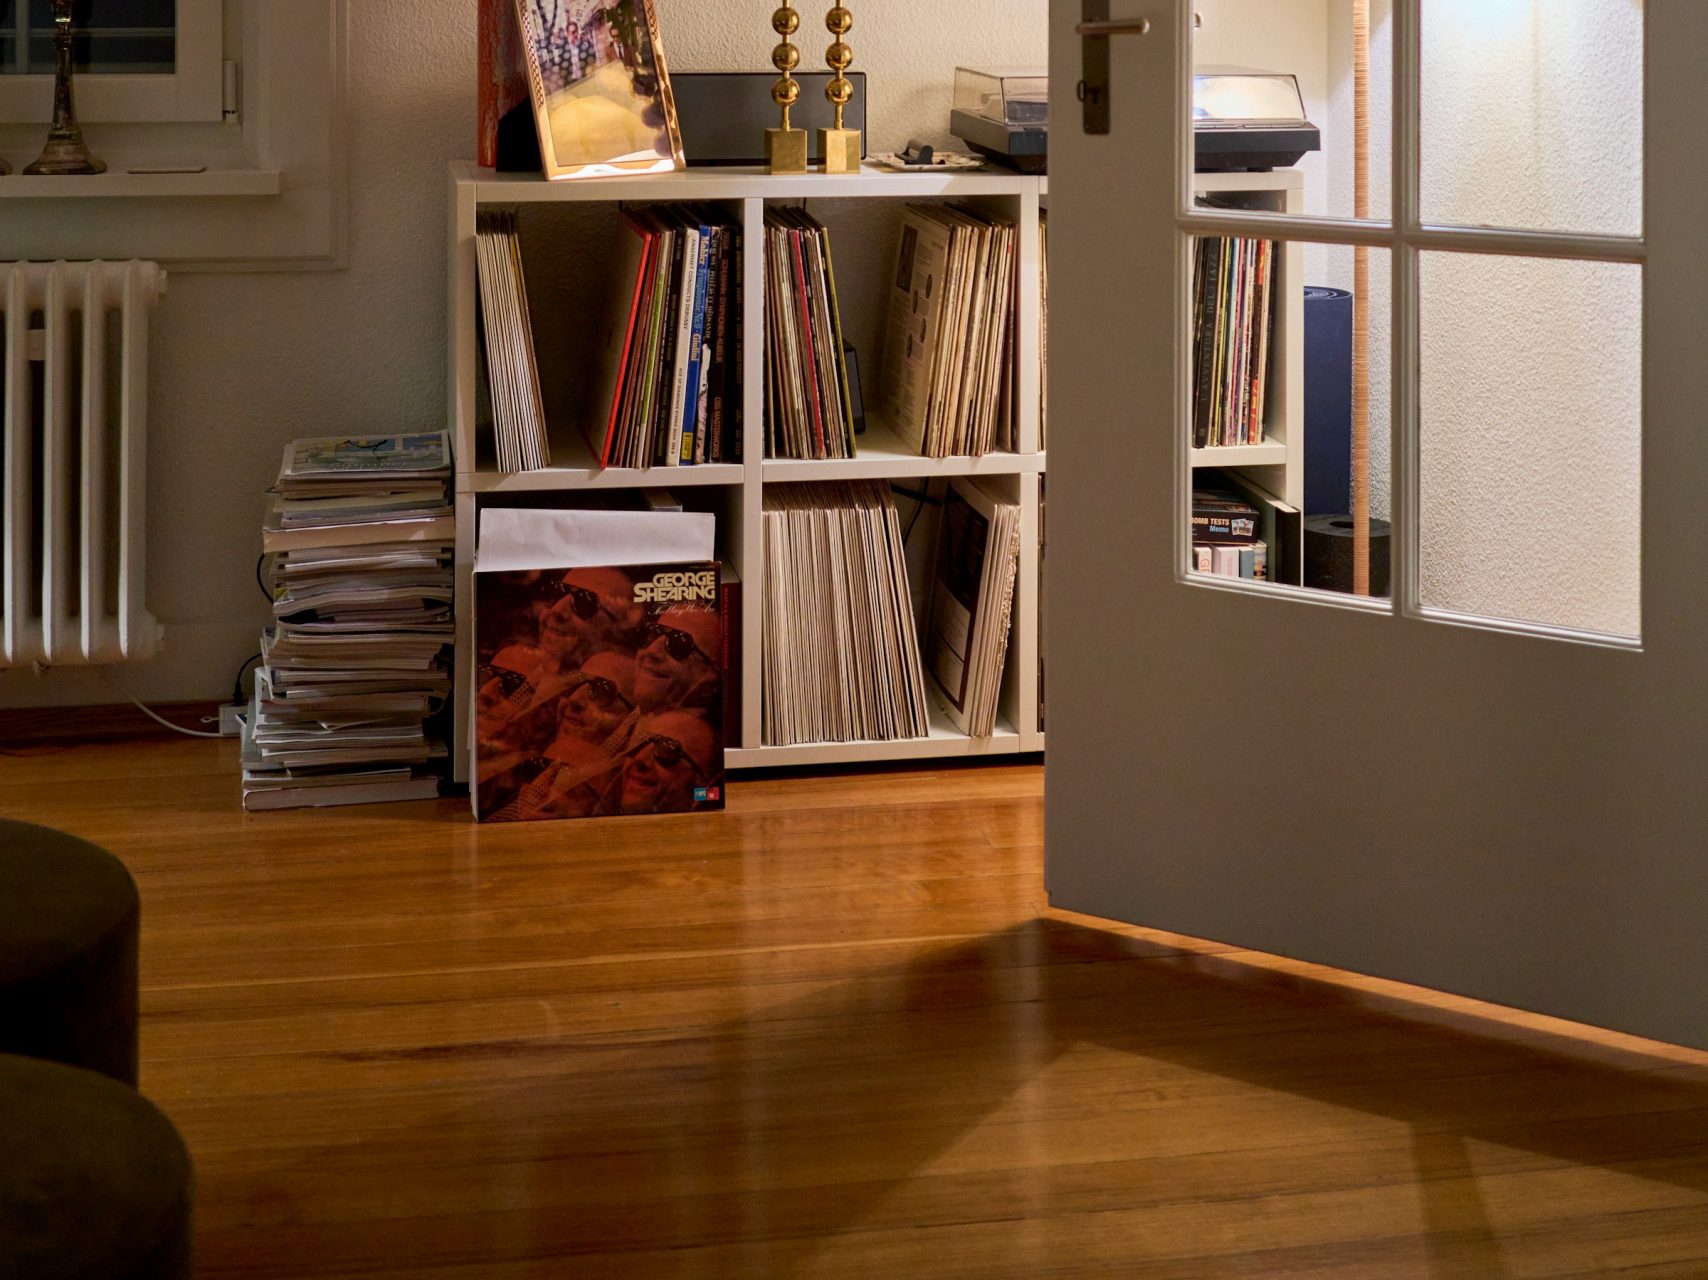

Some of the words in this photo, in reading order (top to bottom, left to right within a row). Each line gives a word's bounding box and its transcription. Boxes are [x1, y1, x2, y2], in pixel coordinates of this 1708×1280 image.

[700, 235, 709, 265] Mahler
[1208, 253, 1218, 282] JAZZ
[1207, 293, 1216, 314] DEL
[712, 411, 720, 458] MASTERWORKS
[652, 571, 715, 587] GEORGE
[633, 582, 715, 603] SHEARING
